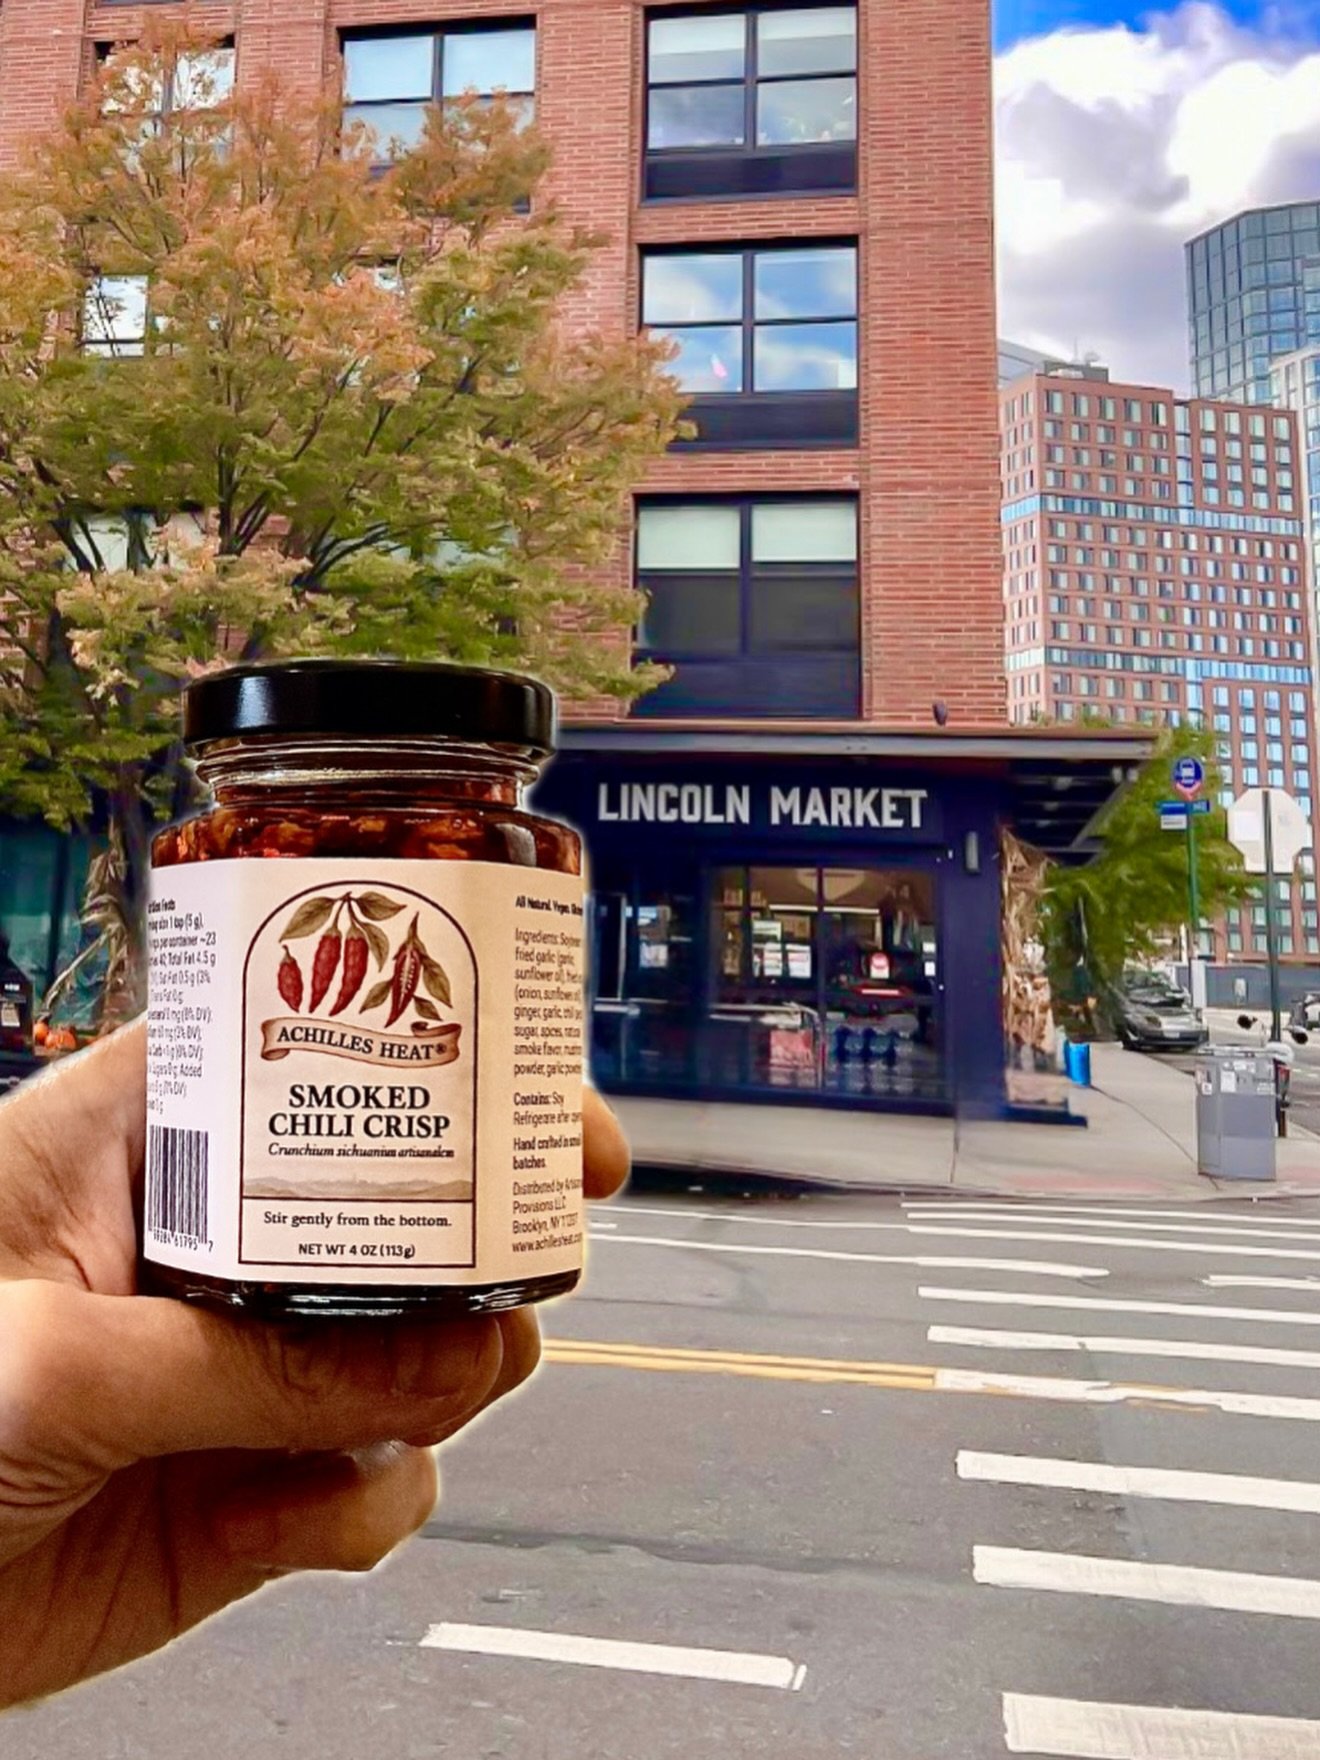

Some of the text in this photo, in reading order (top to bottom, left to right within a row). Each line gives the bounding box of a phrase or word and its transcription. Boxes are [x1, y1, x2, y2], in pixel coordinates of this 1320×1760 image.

[598, 783, 927, 828] LINCOLN MARKET
[277, 1026, 374, 1054] ACHILLES
[289, 1084, 431, 1110] SMOKED
[268, 1112, 451, 1139] CHILI CRISP
[268, 1142, 334, 1157] Crunchium
[264, 1211, 452, 1228] Stir gently from the bottom.
[298, 1243, 323, 1256] NET
[326, 1244, 346, 1256] WT
[349, 1244, 358, 1256] 4
[360, 1244, 377, 1257] OZ
